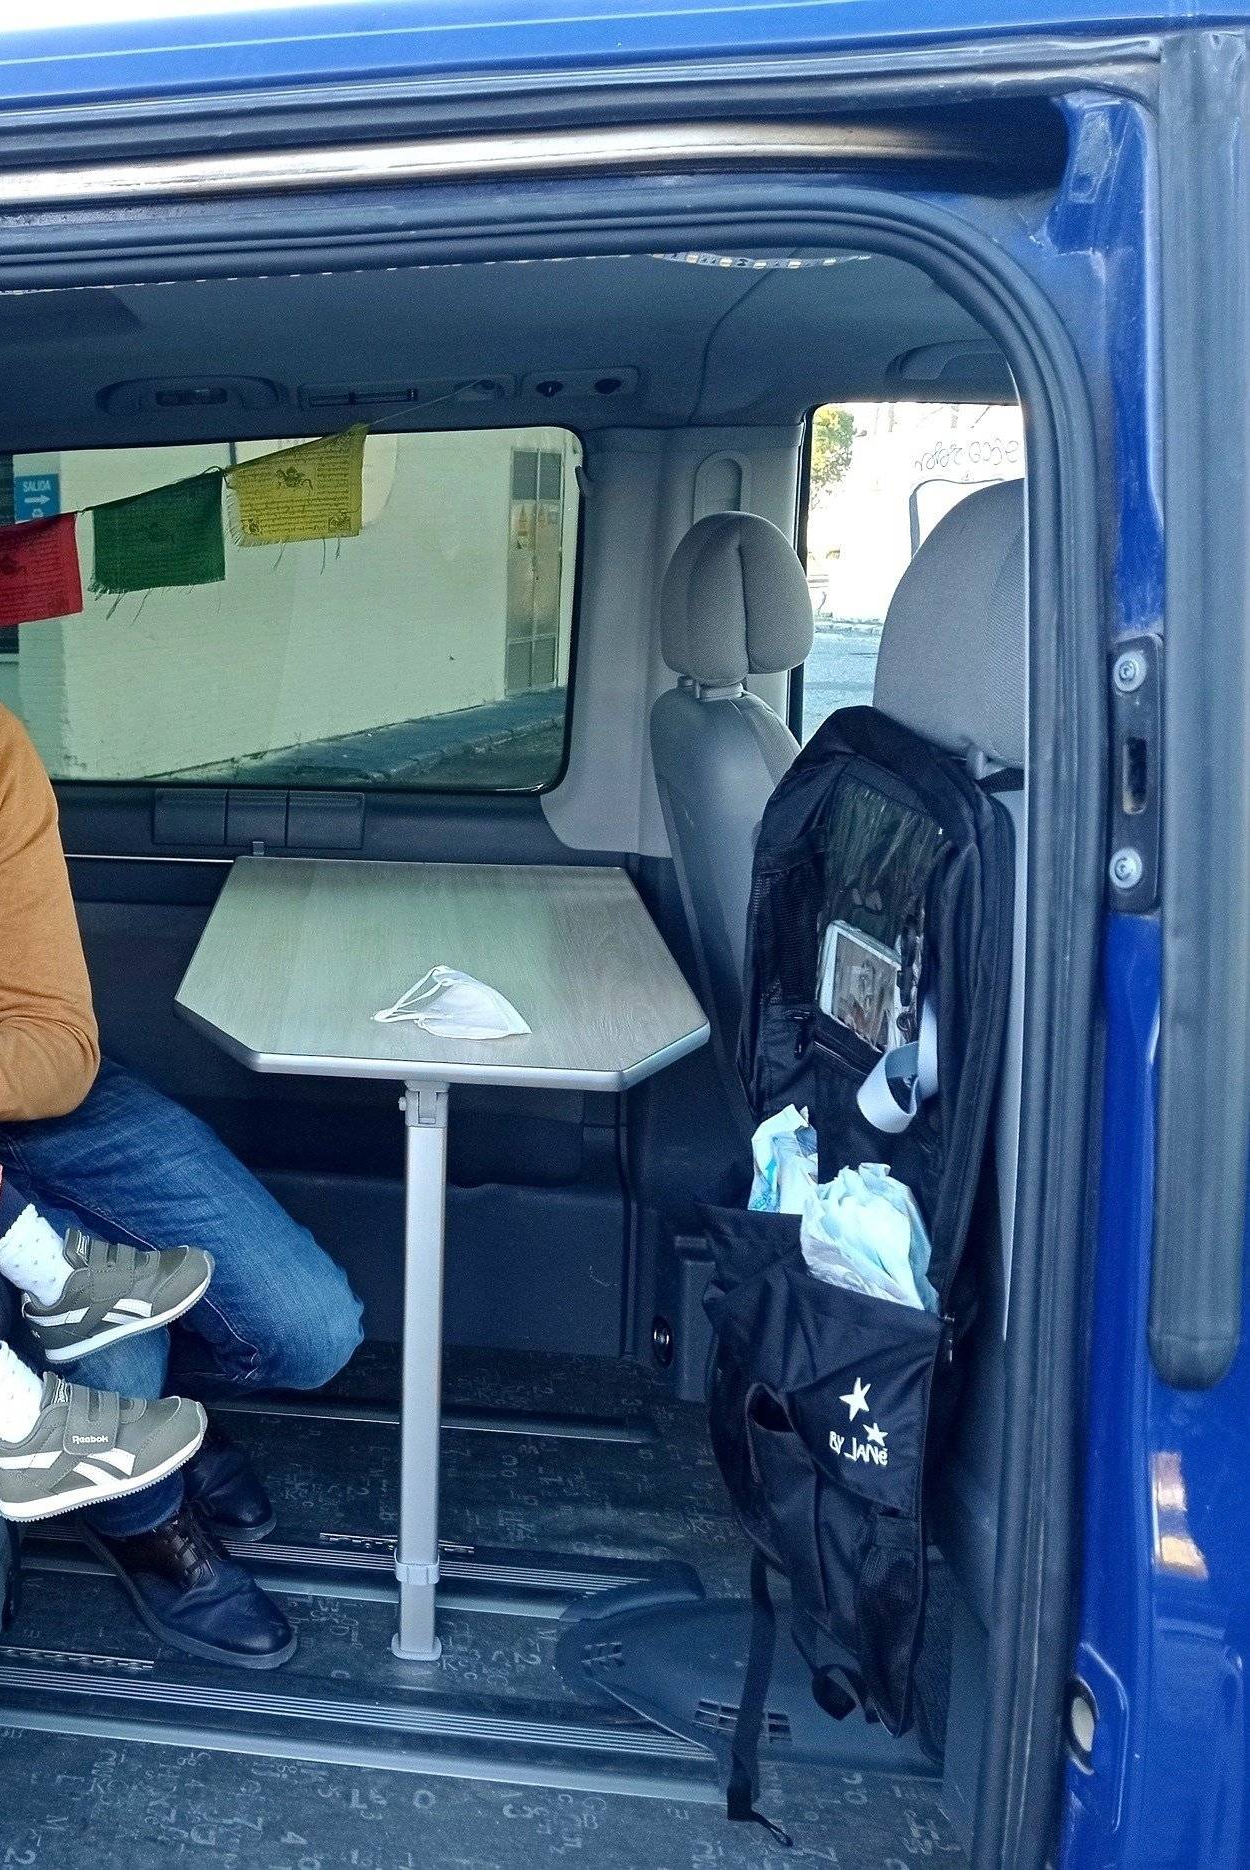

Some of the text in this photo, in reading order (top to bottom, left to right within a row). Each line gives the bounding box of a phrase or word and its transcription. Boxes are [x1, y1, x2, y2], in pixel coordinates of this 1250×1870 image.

[23, 480, 51, 492] SALIDA
[72, 1435, 109, 1445] Reebok
[830, 1431, 844, 1454] BY
